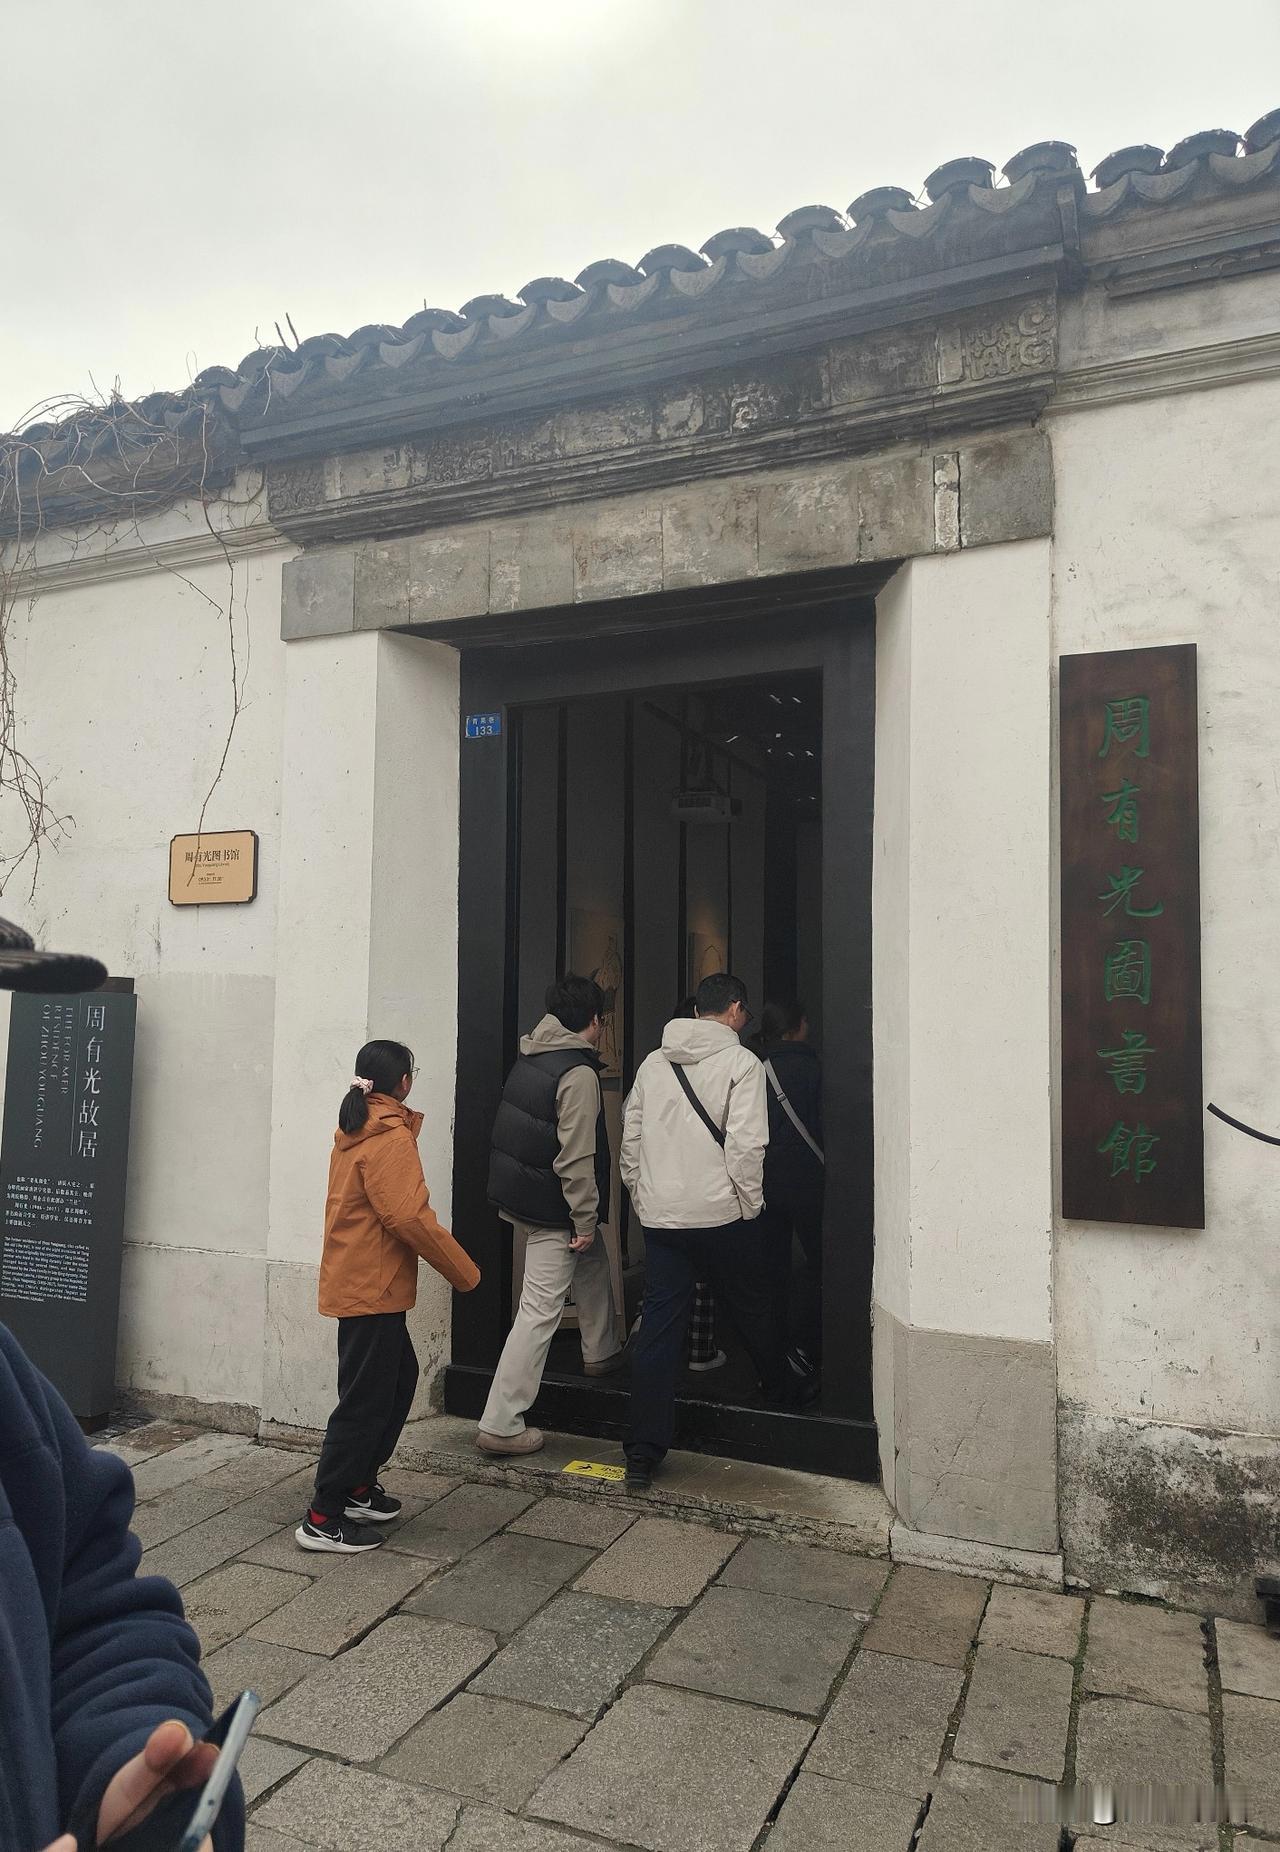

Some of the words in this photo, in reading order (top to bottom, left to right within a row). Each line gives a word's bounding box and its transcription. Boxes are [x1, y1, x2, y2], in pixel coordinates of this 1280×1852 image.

[475, 726, 493, 736] 133
[1097, 695, 1164, 1184] 周有光圖書館
[39, 1026, 49, 1066] ZHOU
[50, 1005, 62, 1080] RESIDENCE
[60, 1036, 72, 1094] FORMER
[33, 1069, 47, 1148] YOUGUANG
[77, 1005, 106, 1158] 周有光故居
